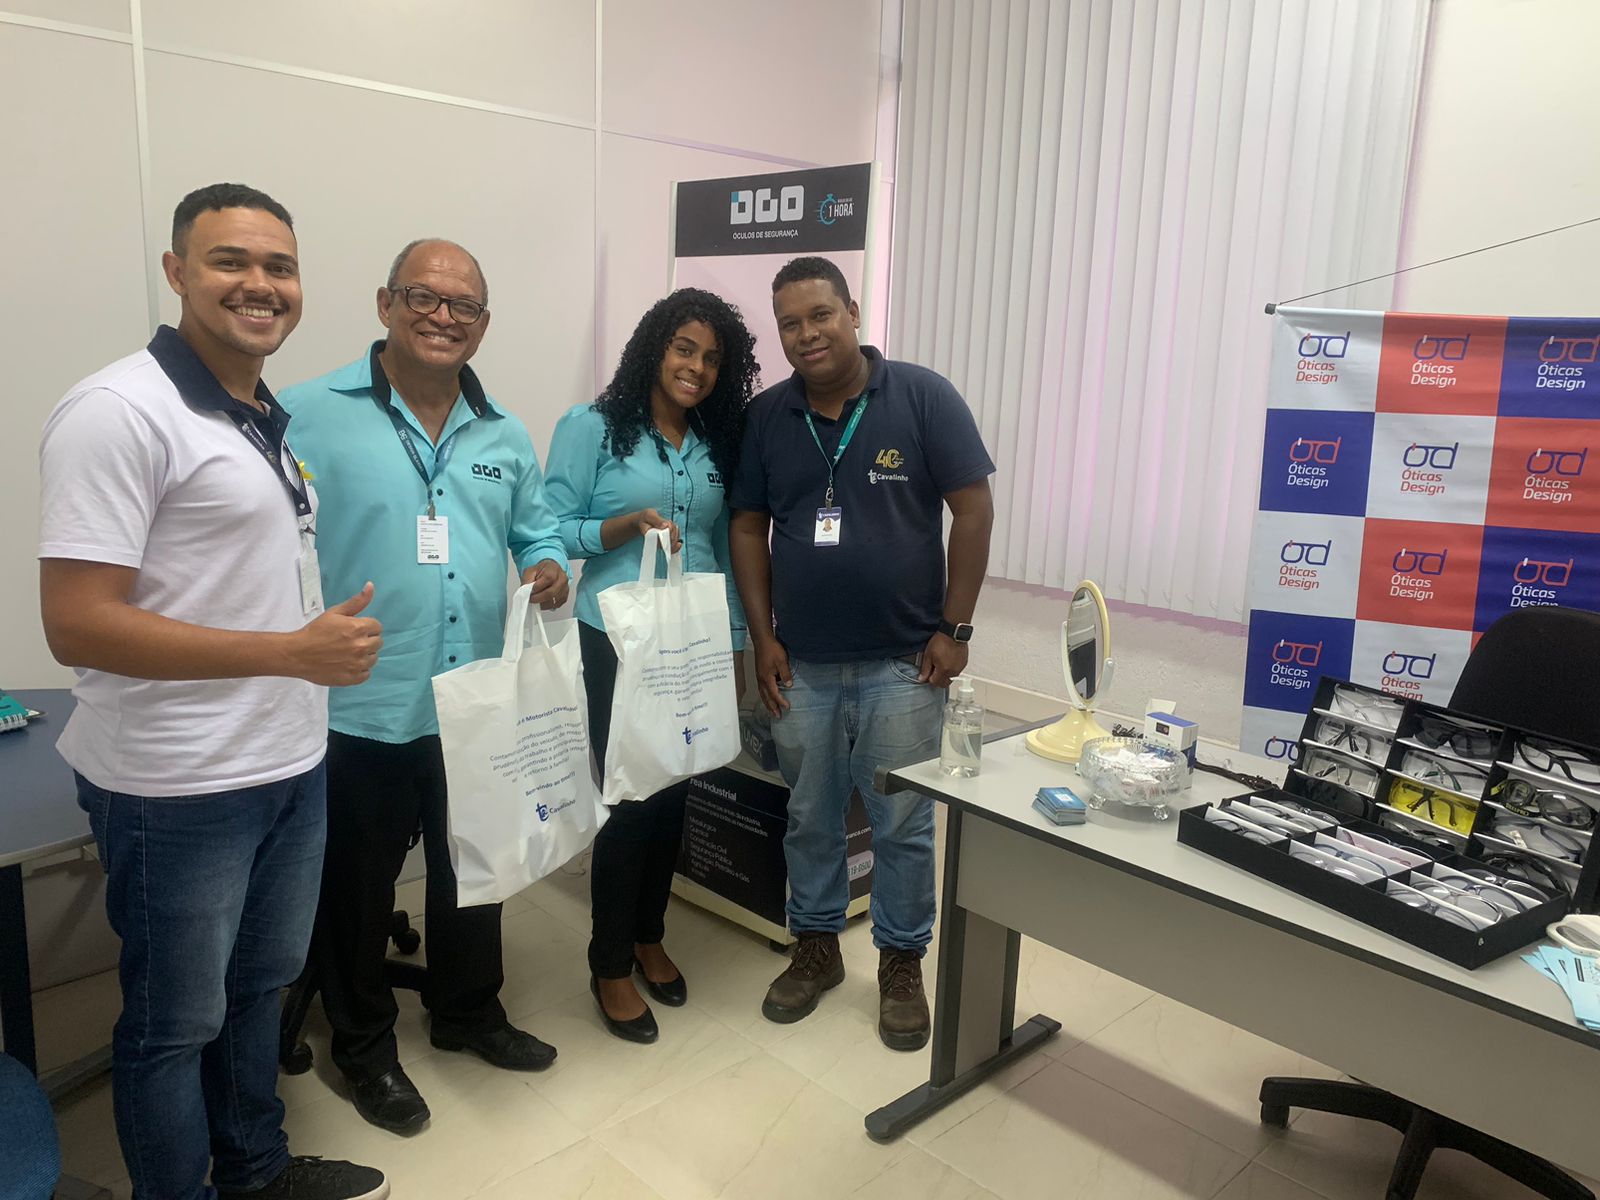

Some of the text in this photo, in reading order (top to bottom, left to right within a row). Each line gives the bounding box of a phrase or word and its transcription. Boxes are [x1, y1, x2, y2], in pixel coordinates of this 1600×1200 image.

[834, 203, 853, 216] HORA
[764, 229, 798, 238] SEGURANÇA
[1297, 358, 1335, 371] Óticas
[1412, 360, 1454, 374] Óticas
[1538, 362, 1583, 376] Óticas
[1296, 372, 1338, 384] Design
[1411, 374, 1456, 388] Design
[1536, 376, 1586, 391] Design
[1288, 462, 1326, 475] Óticas
[1402, 468, 1442, 482] Óticas
[878, 474, 908, 482] Cavalinho
[1288, 476, 1328, 488] Design
[1525, 474, 1569, 489] Óticas
[1400, 482, 1444, 495] Design
[1523, 489, 1572, 503] Design
[1280, 564, 1317, 577] Óticas
[1278, 576, 1319, 590] Design
[1391, 573, 1431, 588] Óticas
[1390, 586, 1434, 600] Design
[1512, 582, 1556, 598] Óticas
[1271, 662, 1308, 677] Óticas
[1270, 674, 1310, 689] Design
[1382, 675, 1420, 690] Óticas
[690, 778, 737, 801] rea Industrial
